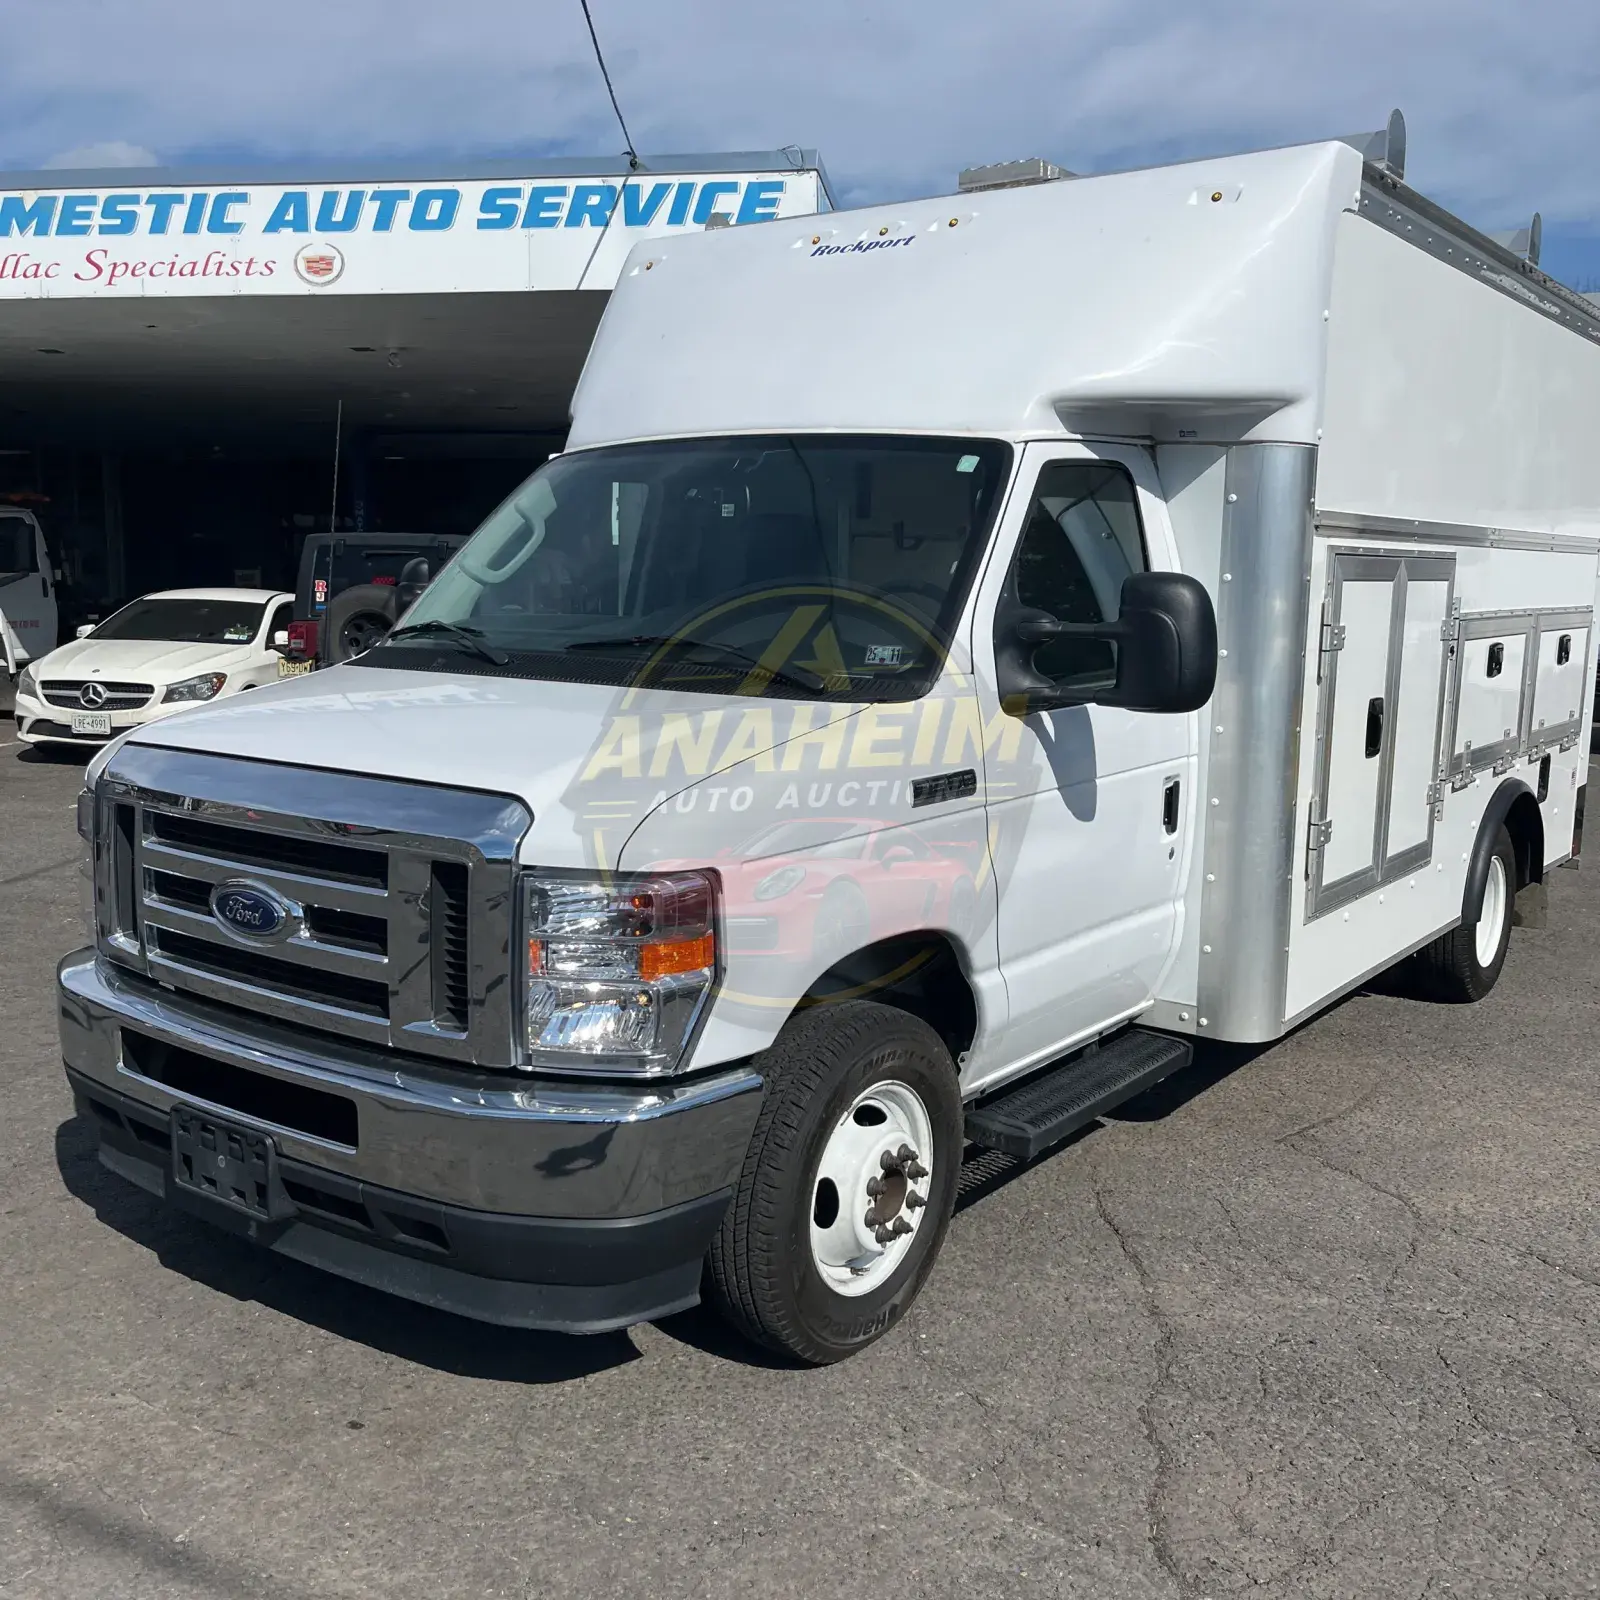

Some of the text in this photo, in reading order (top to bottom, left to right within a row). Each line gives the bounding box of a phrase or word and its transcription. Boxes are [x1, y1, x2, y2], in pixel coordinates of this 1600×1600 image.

[262, 188, 463, 234] AUTO
[476, 180, 786, 232] SERVICE
[810, 235, 916, 257] Rockport
[74, 249, 277, 287] Specialists
[226, 895, 264, 925] Ford
